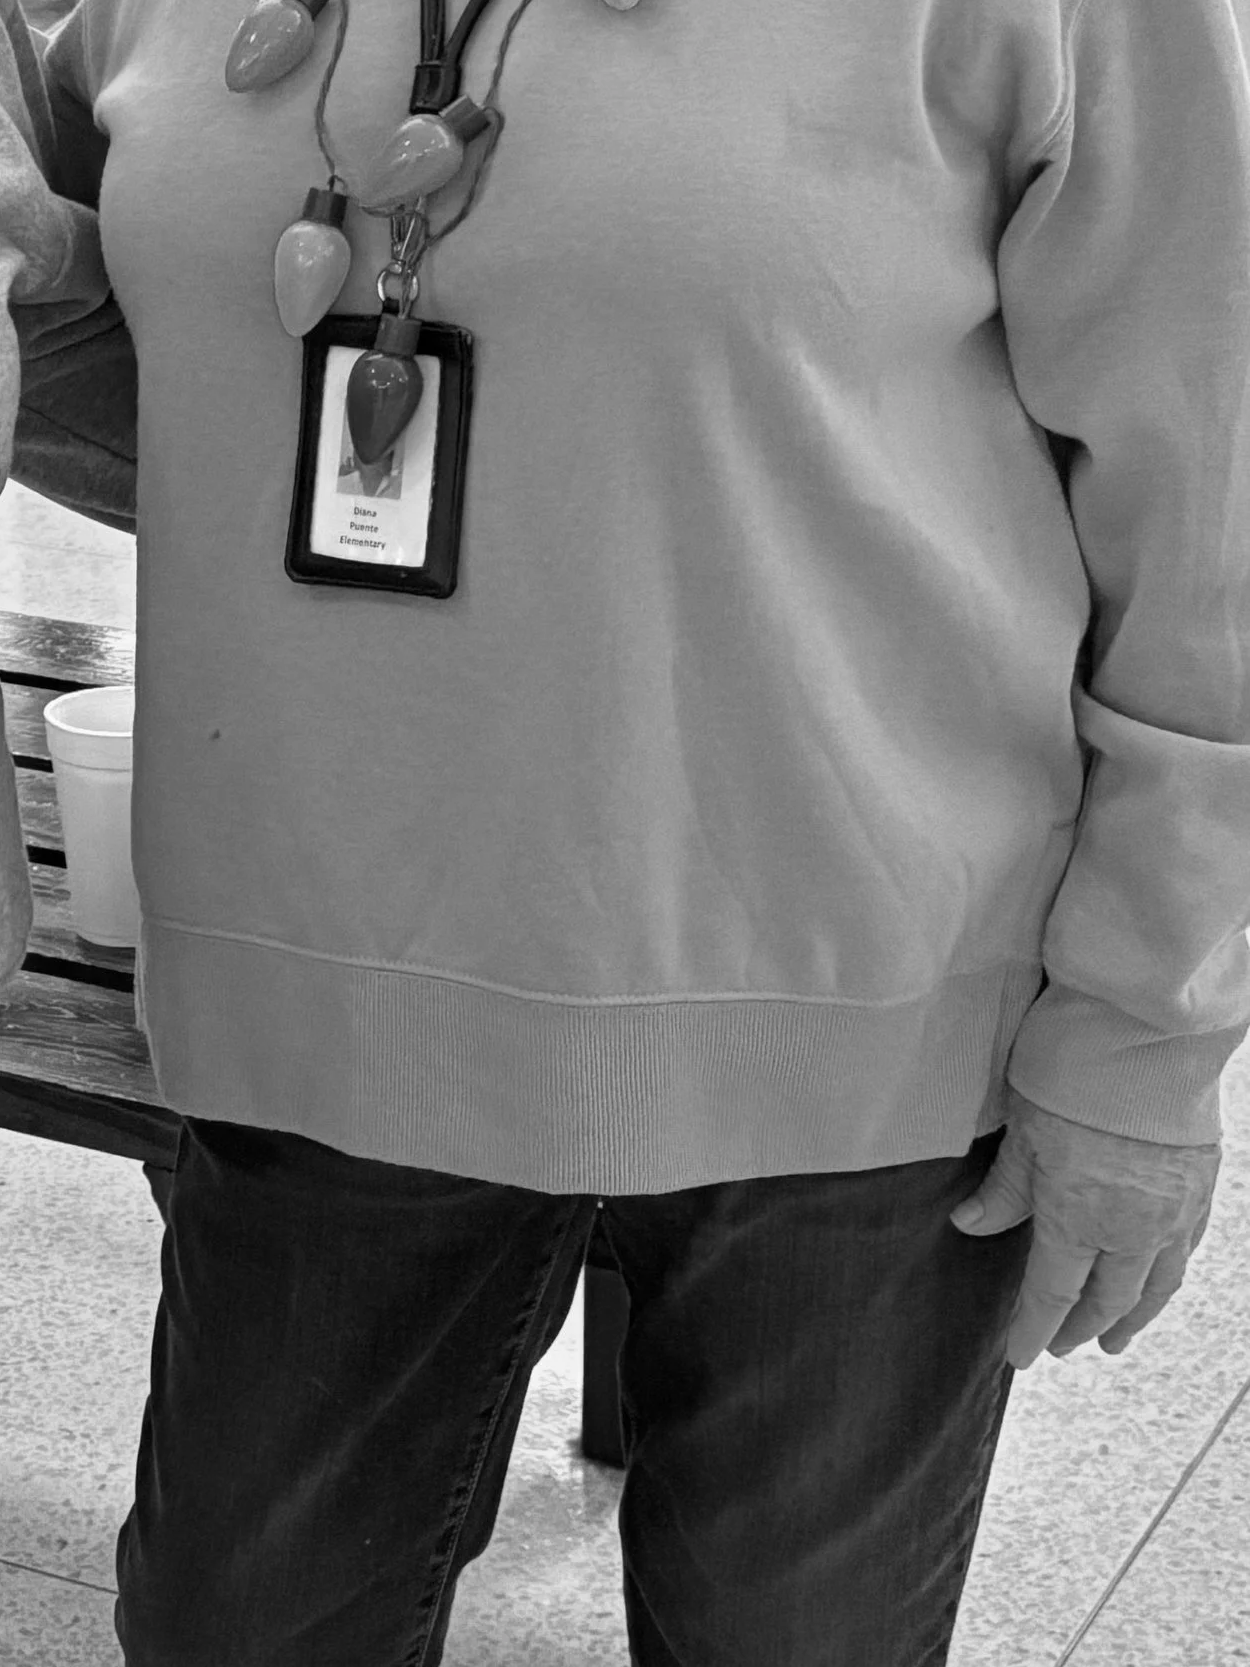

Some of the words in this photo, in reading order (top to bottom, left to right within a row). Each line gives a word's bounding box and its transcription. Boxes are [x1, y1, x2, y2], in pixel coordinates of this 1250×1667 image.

[353, 506, 377, 518] Diana
[350, 521, 379, 534] Puente
[339, 535, 386, 550] Elementary
